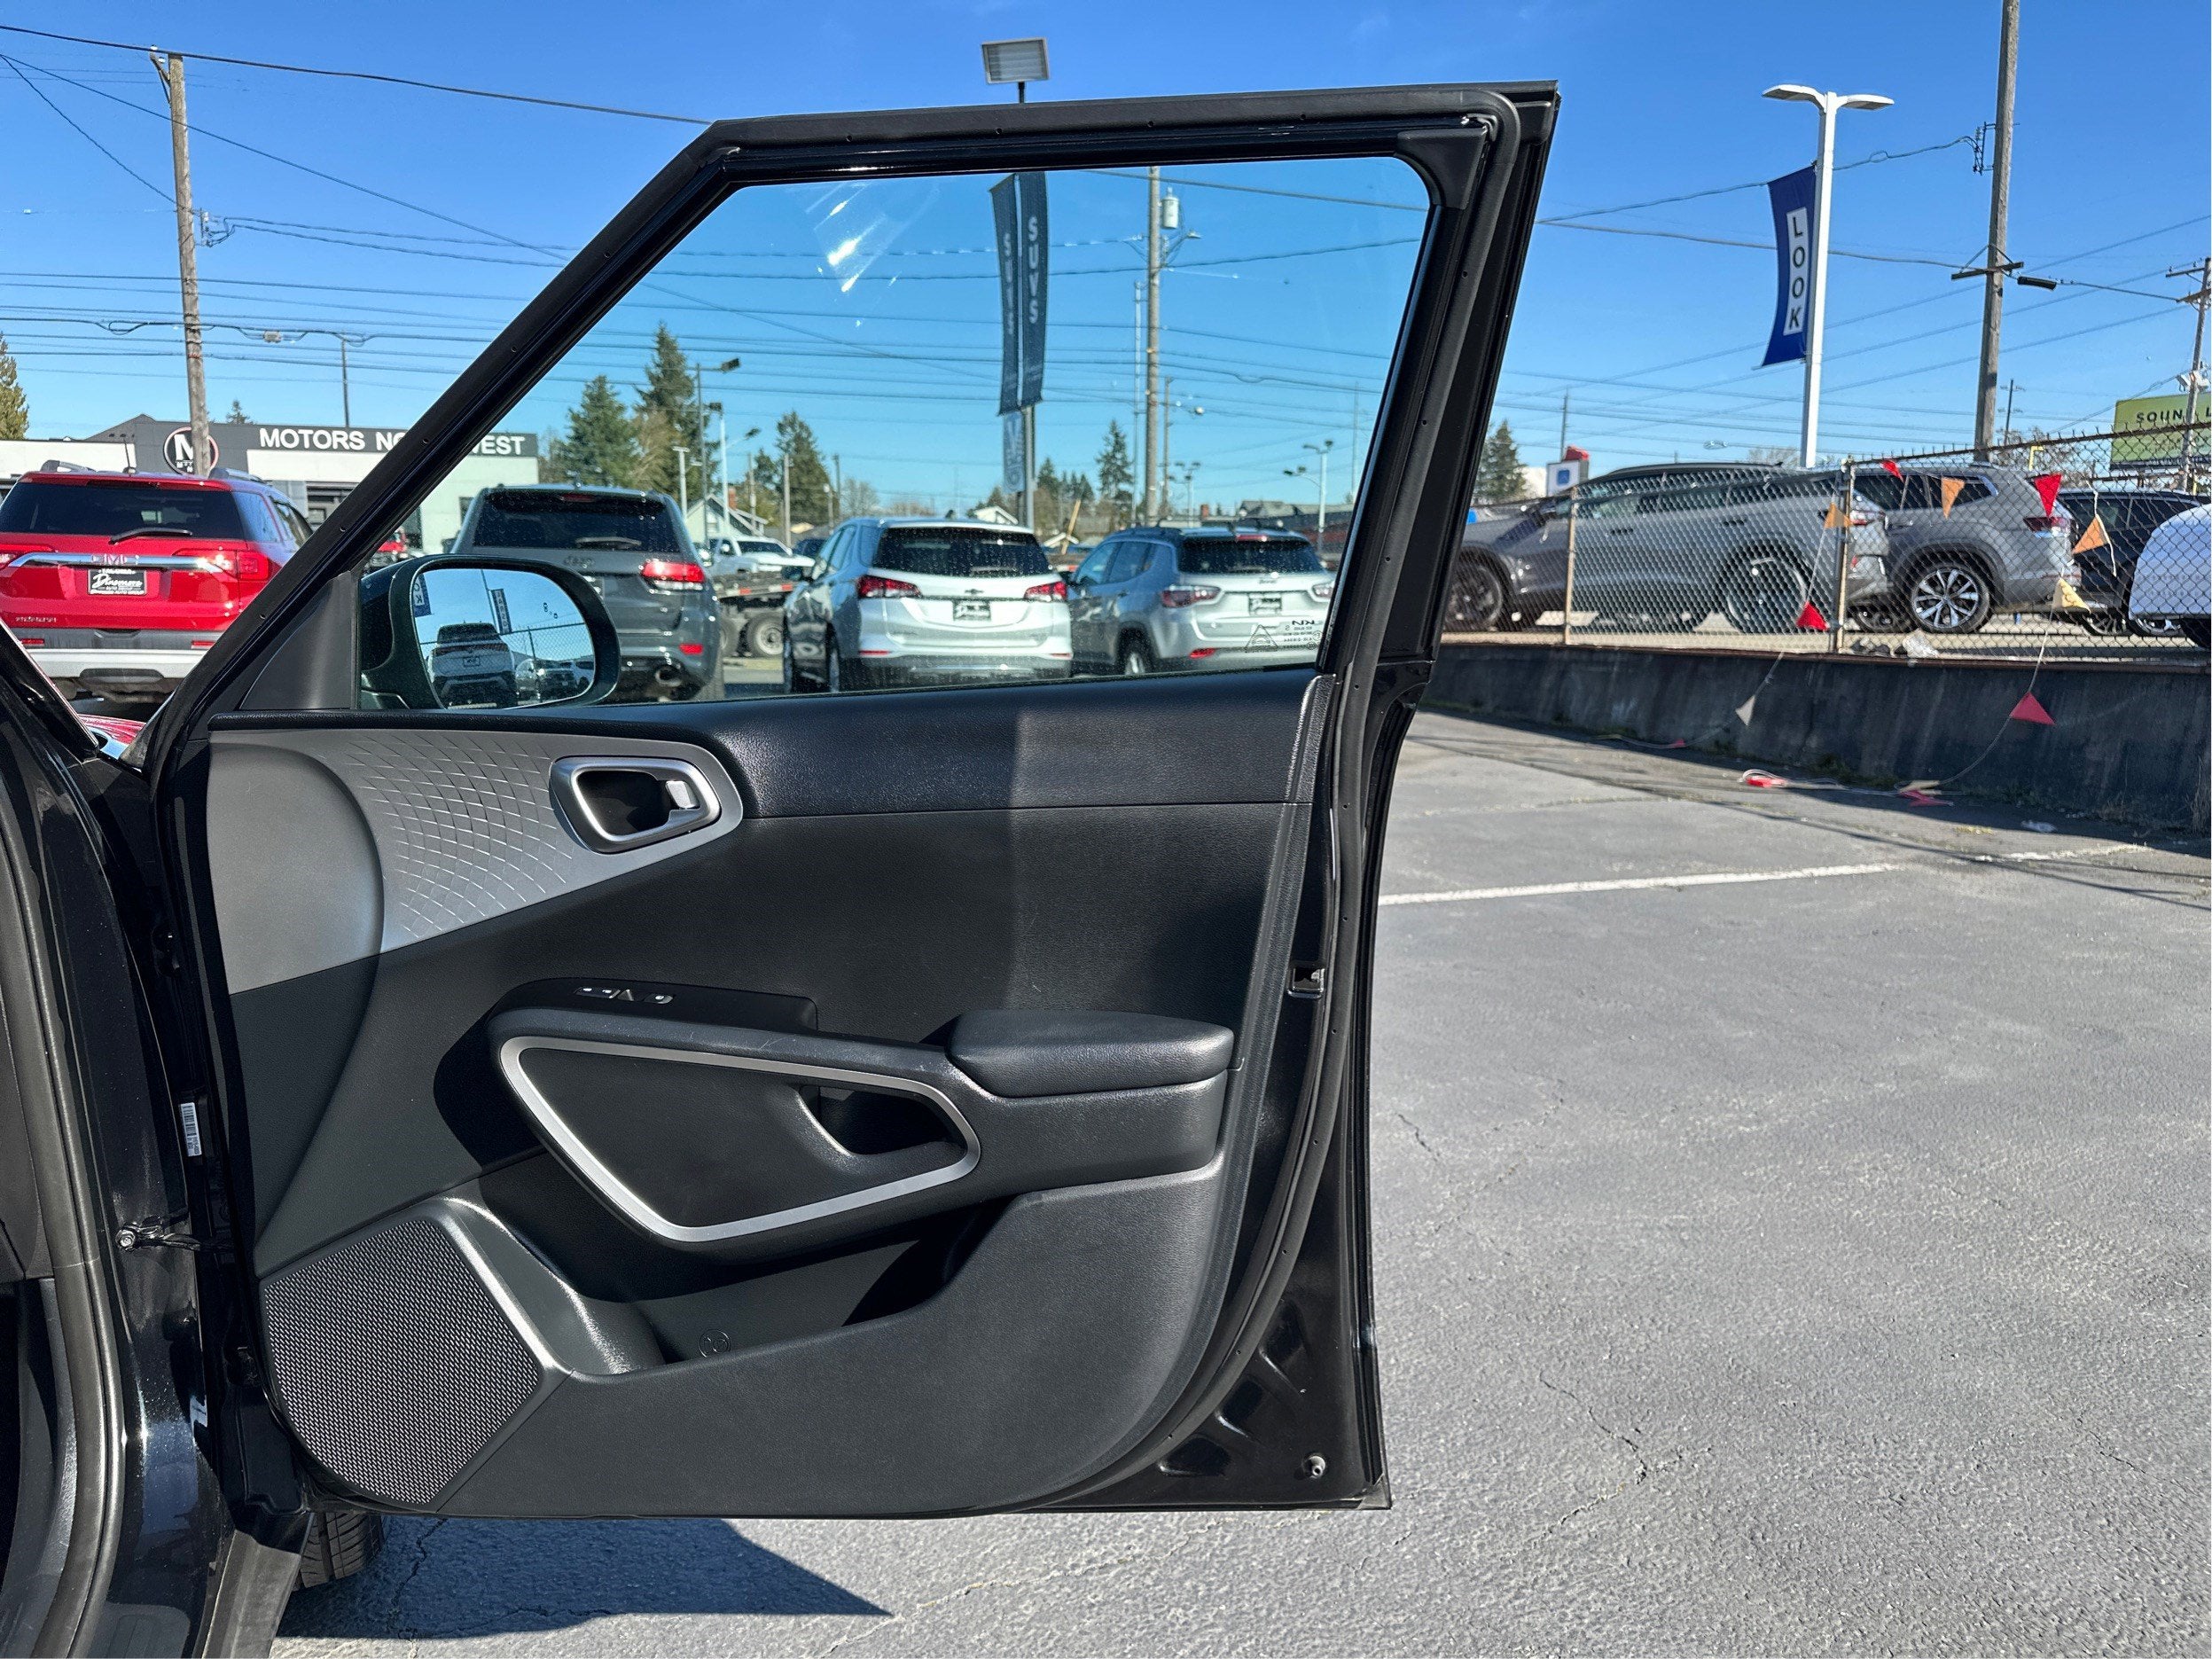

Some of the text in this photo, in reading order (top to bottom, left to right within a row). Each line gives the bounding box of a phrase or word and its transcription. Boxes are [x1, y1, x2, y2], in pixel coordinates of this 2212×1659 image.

[1028, 215, 1040, 325] SUVS
[1788, 216, 1806, 331] LOOK
[259, 427, 364, 450] MOTORS
[2136, 409, 2184, 423] SOUN
